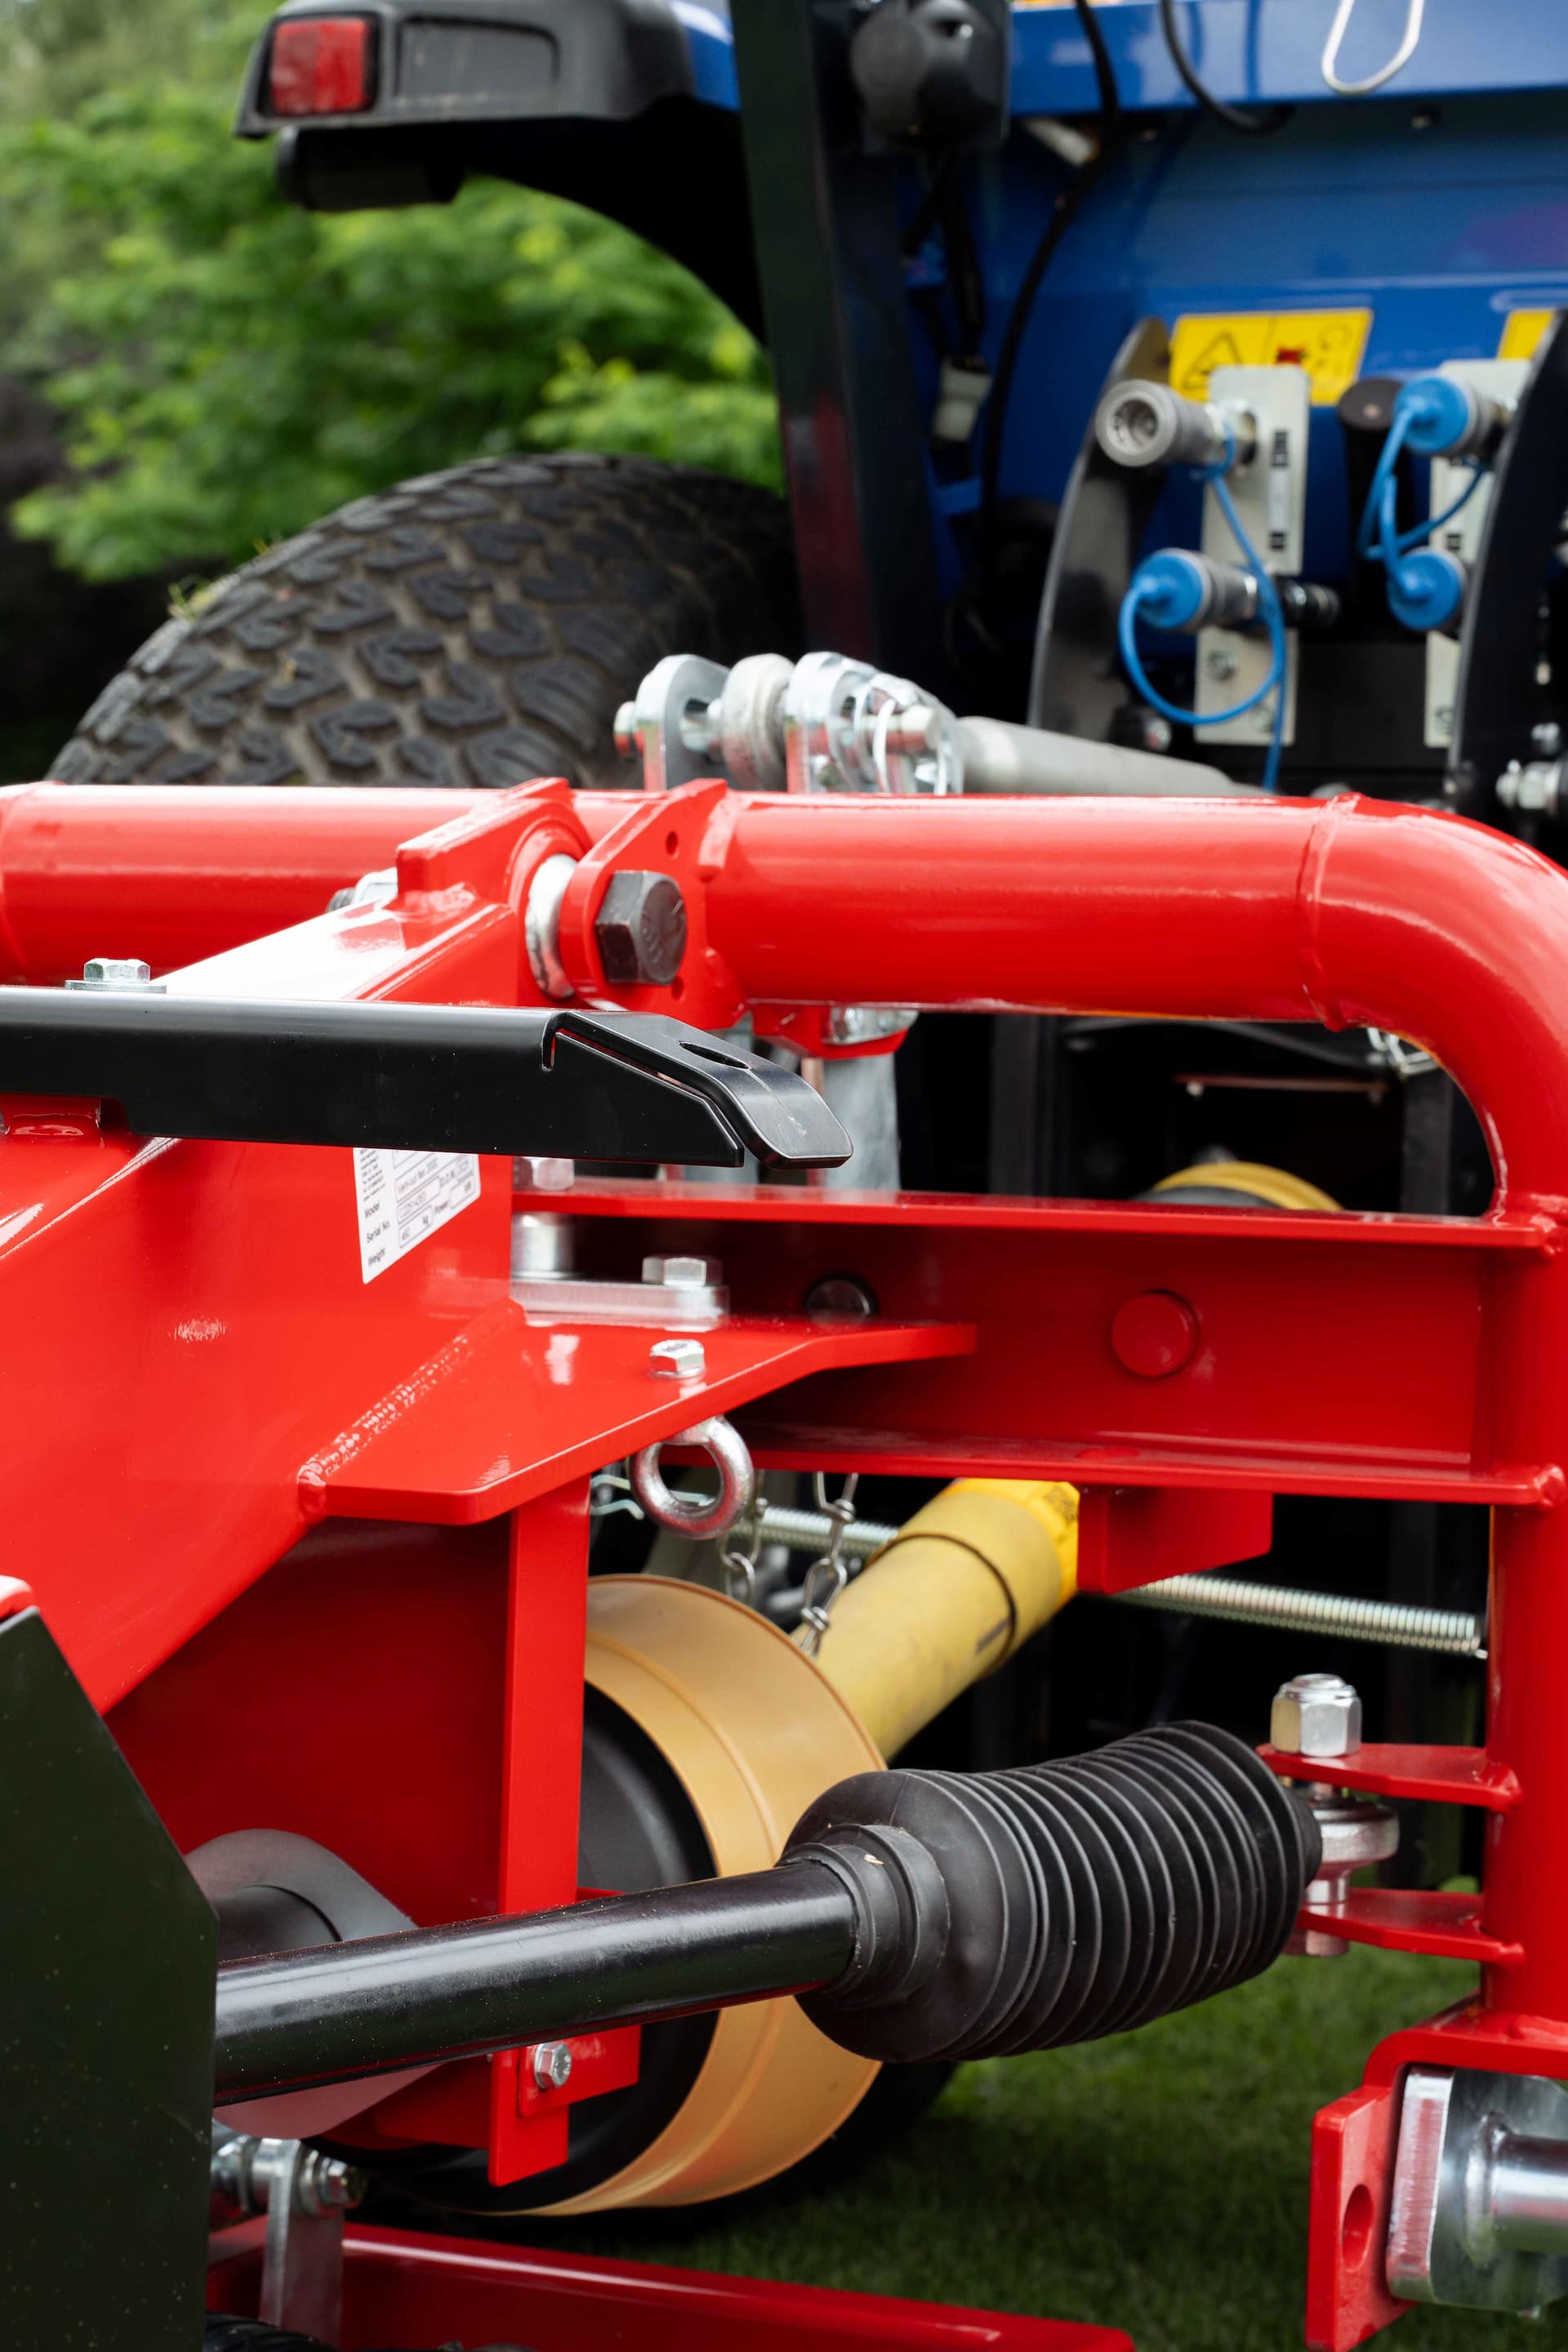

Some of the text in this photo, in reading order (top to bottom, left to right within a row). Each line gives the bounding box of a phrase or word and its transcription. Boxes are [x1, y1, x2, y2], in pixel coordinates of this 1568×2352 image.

[364, 1203, 381, 1218] Model
[367, 1227, 381, 1243] Serial
[368, 1248, 385, 1267] Weight
